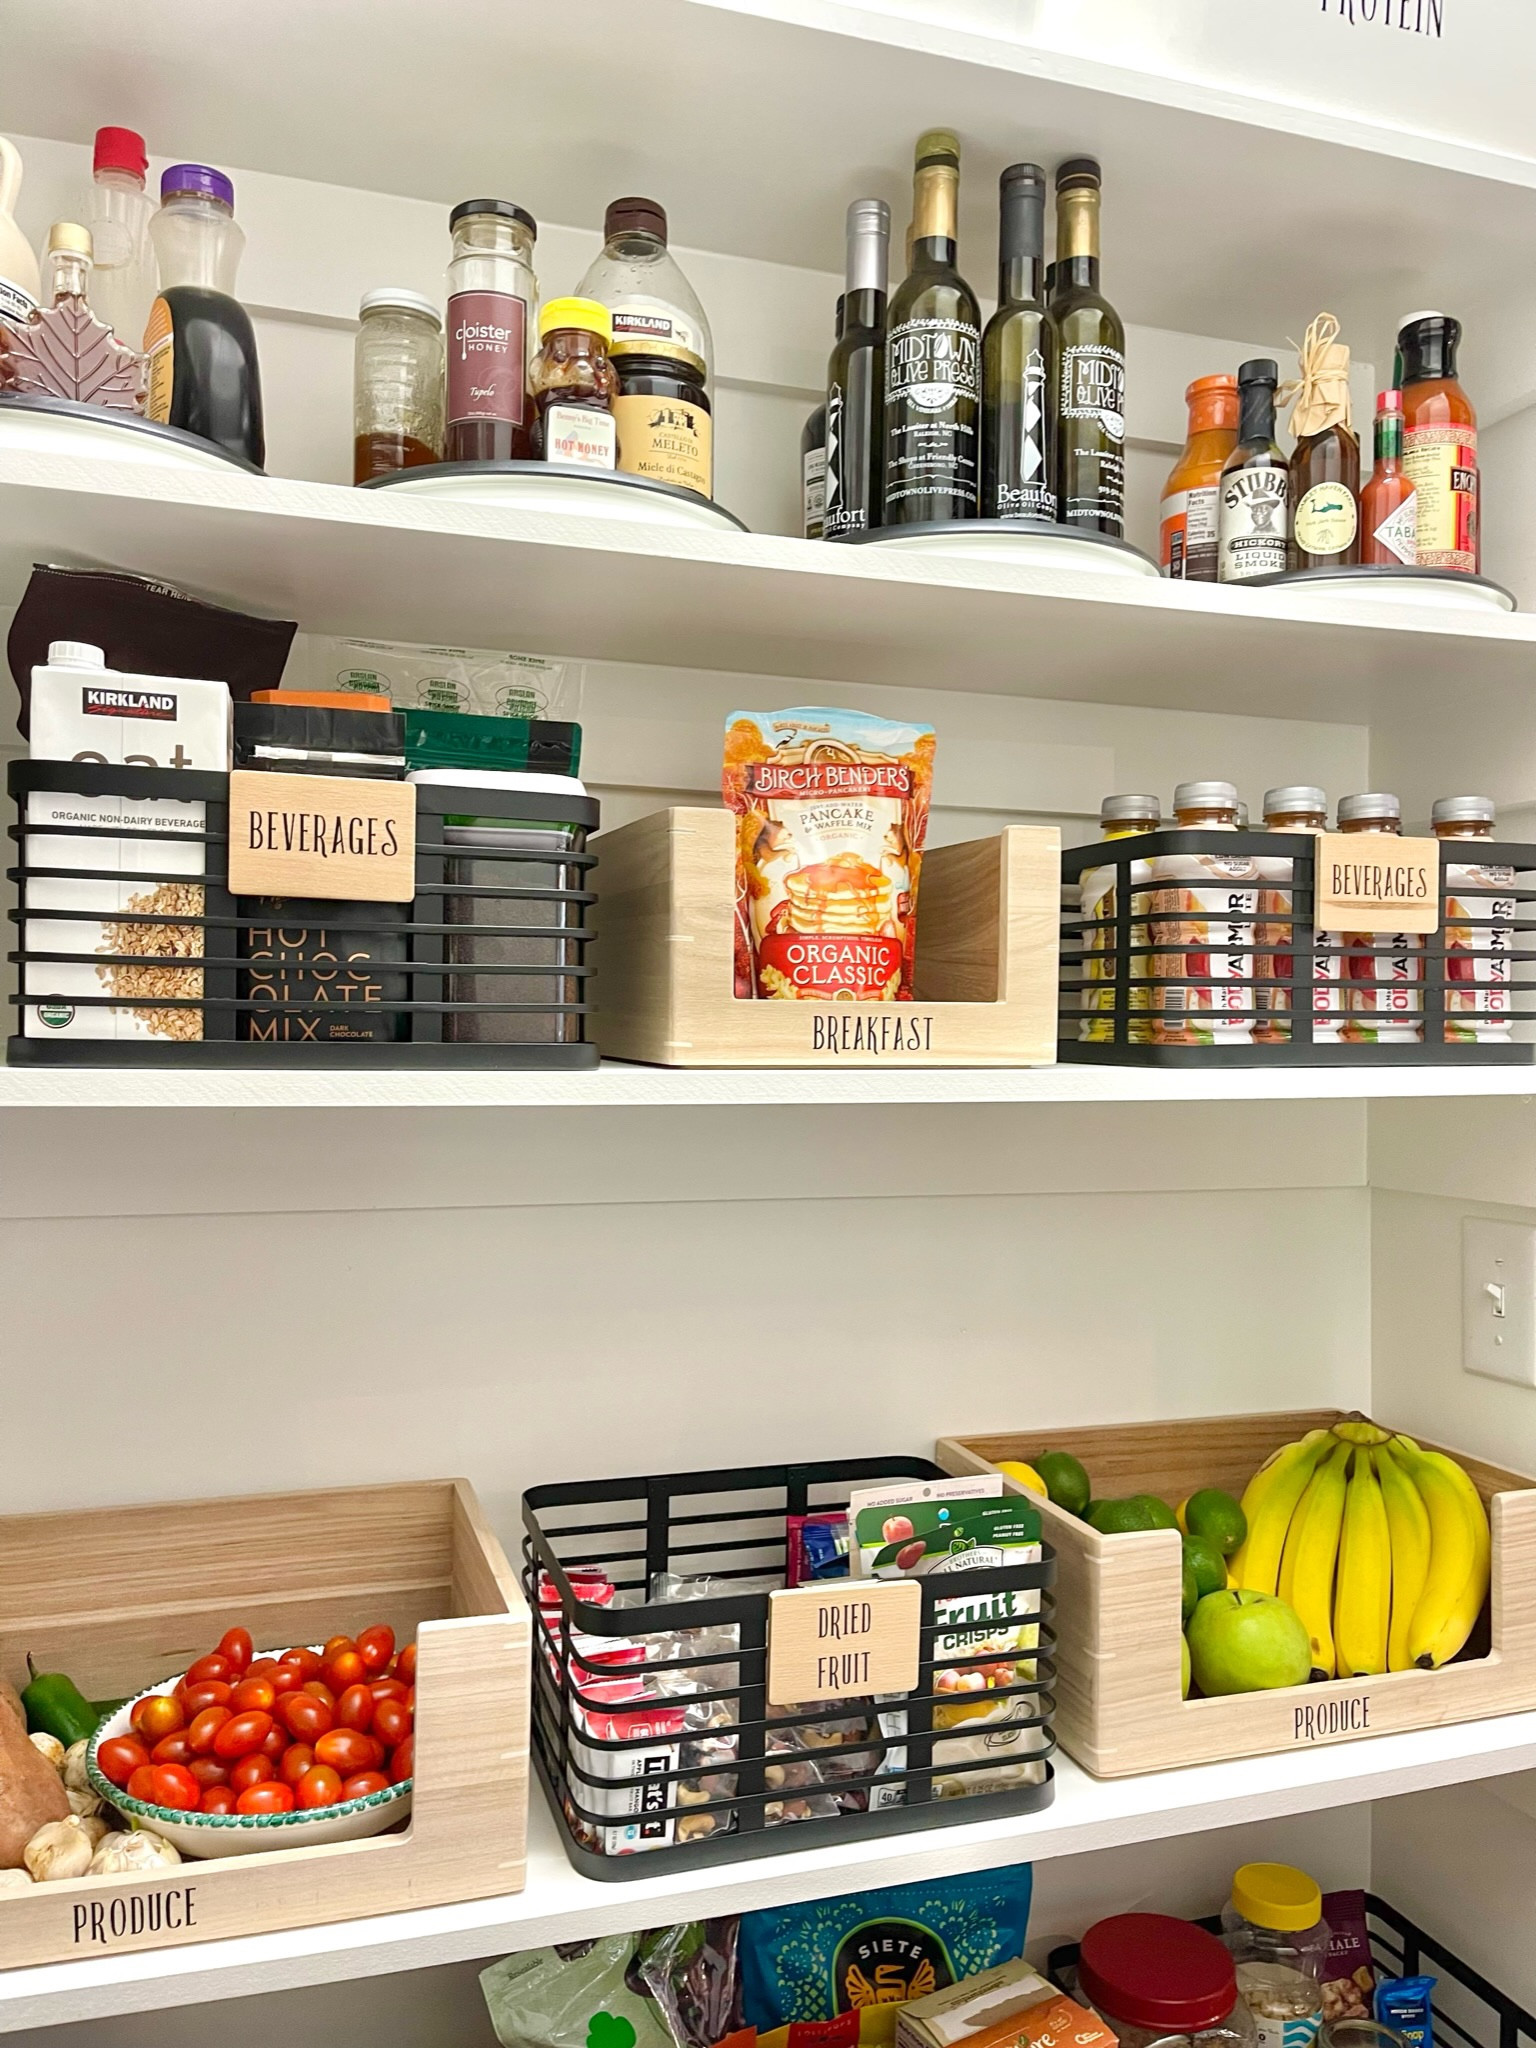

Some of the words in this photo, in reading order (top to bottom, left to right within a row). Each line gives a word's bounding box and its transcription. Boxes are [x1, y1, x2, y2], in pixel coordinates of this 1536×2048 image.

[615, 314, 671, 331] KIRKLAND
[456, 319, 512, 350] cloister
[468, 343, 508, 353] HONEY
[470, 384, 496, 401] Tupelo
[555, 438, 574, 451] HOT
[652, 437, 698, 457] MELETO
[637, 461, 664, 473] Miele
[666, 462, 675, 474] di
[146, 584, 168, 596] TEAR
[87, 690, 174, 710] KIRKLAND
[755, 767, 823, 793] BIRCH
[826, 766, 909, 792] BENDERS
[51, 811, 97, 822] ORGANIC
[99, 814, 152, 825] NON-DAIRY
[155, 818, 206, 828] BEVERAGE
[800, 808, 874, 825] PANCAKE
[814, 820, 853, 830] WAFFLE
[248, 810, 399, 858] BEVERAGES
[1332, 864, 1428, 900] BEVERAGES
[249, 951, 371, 980] CHOC
[787, 944, 890, 966] ORGANIC
[793, 965, 886, 987] CLASSIC
[249, 1017, 321, 1041] MIX
[812, 1014, 934, 1056] BREAKFAST
[896, 1496, 913, 1504] SUGAR
[955, 1556, 994, 1568] NATURAL
[934, 1590, 1017, 1625] Fruit
[818, 1602, 872, 1640] DRIED
[818, 1651, 871, 1689] FRUIT
[1294, 1696, 1370, 1741] PRODUCE
[881, 1791, 892, 1802] 40
[72, 1886, 198, 1945] PRODUCE
[858, 1939, 923, 1960] SIETE
